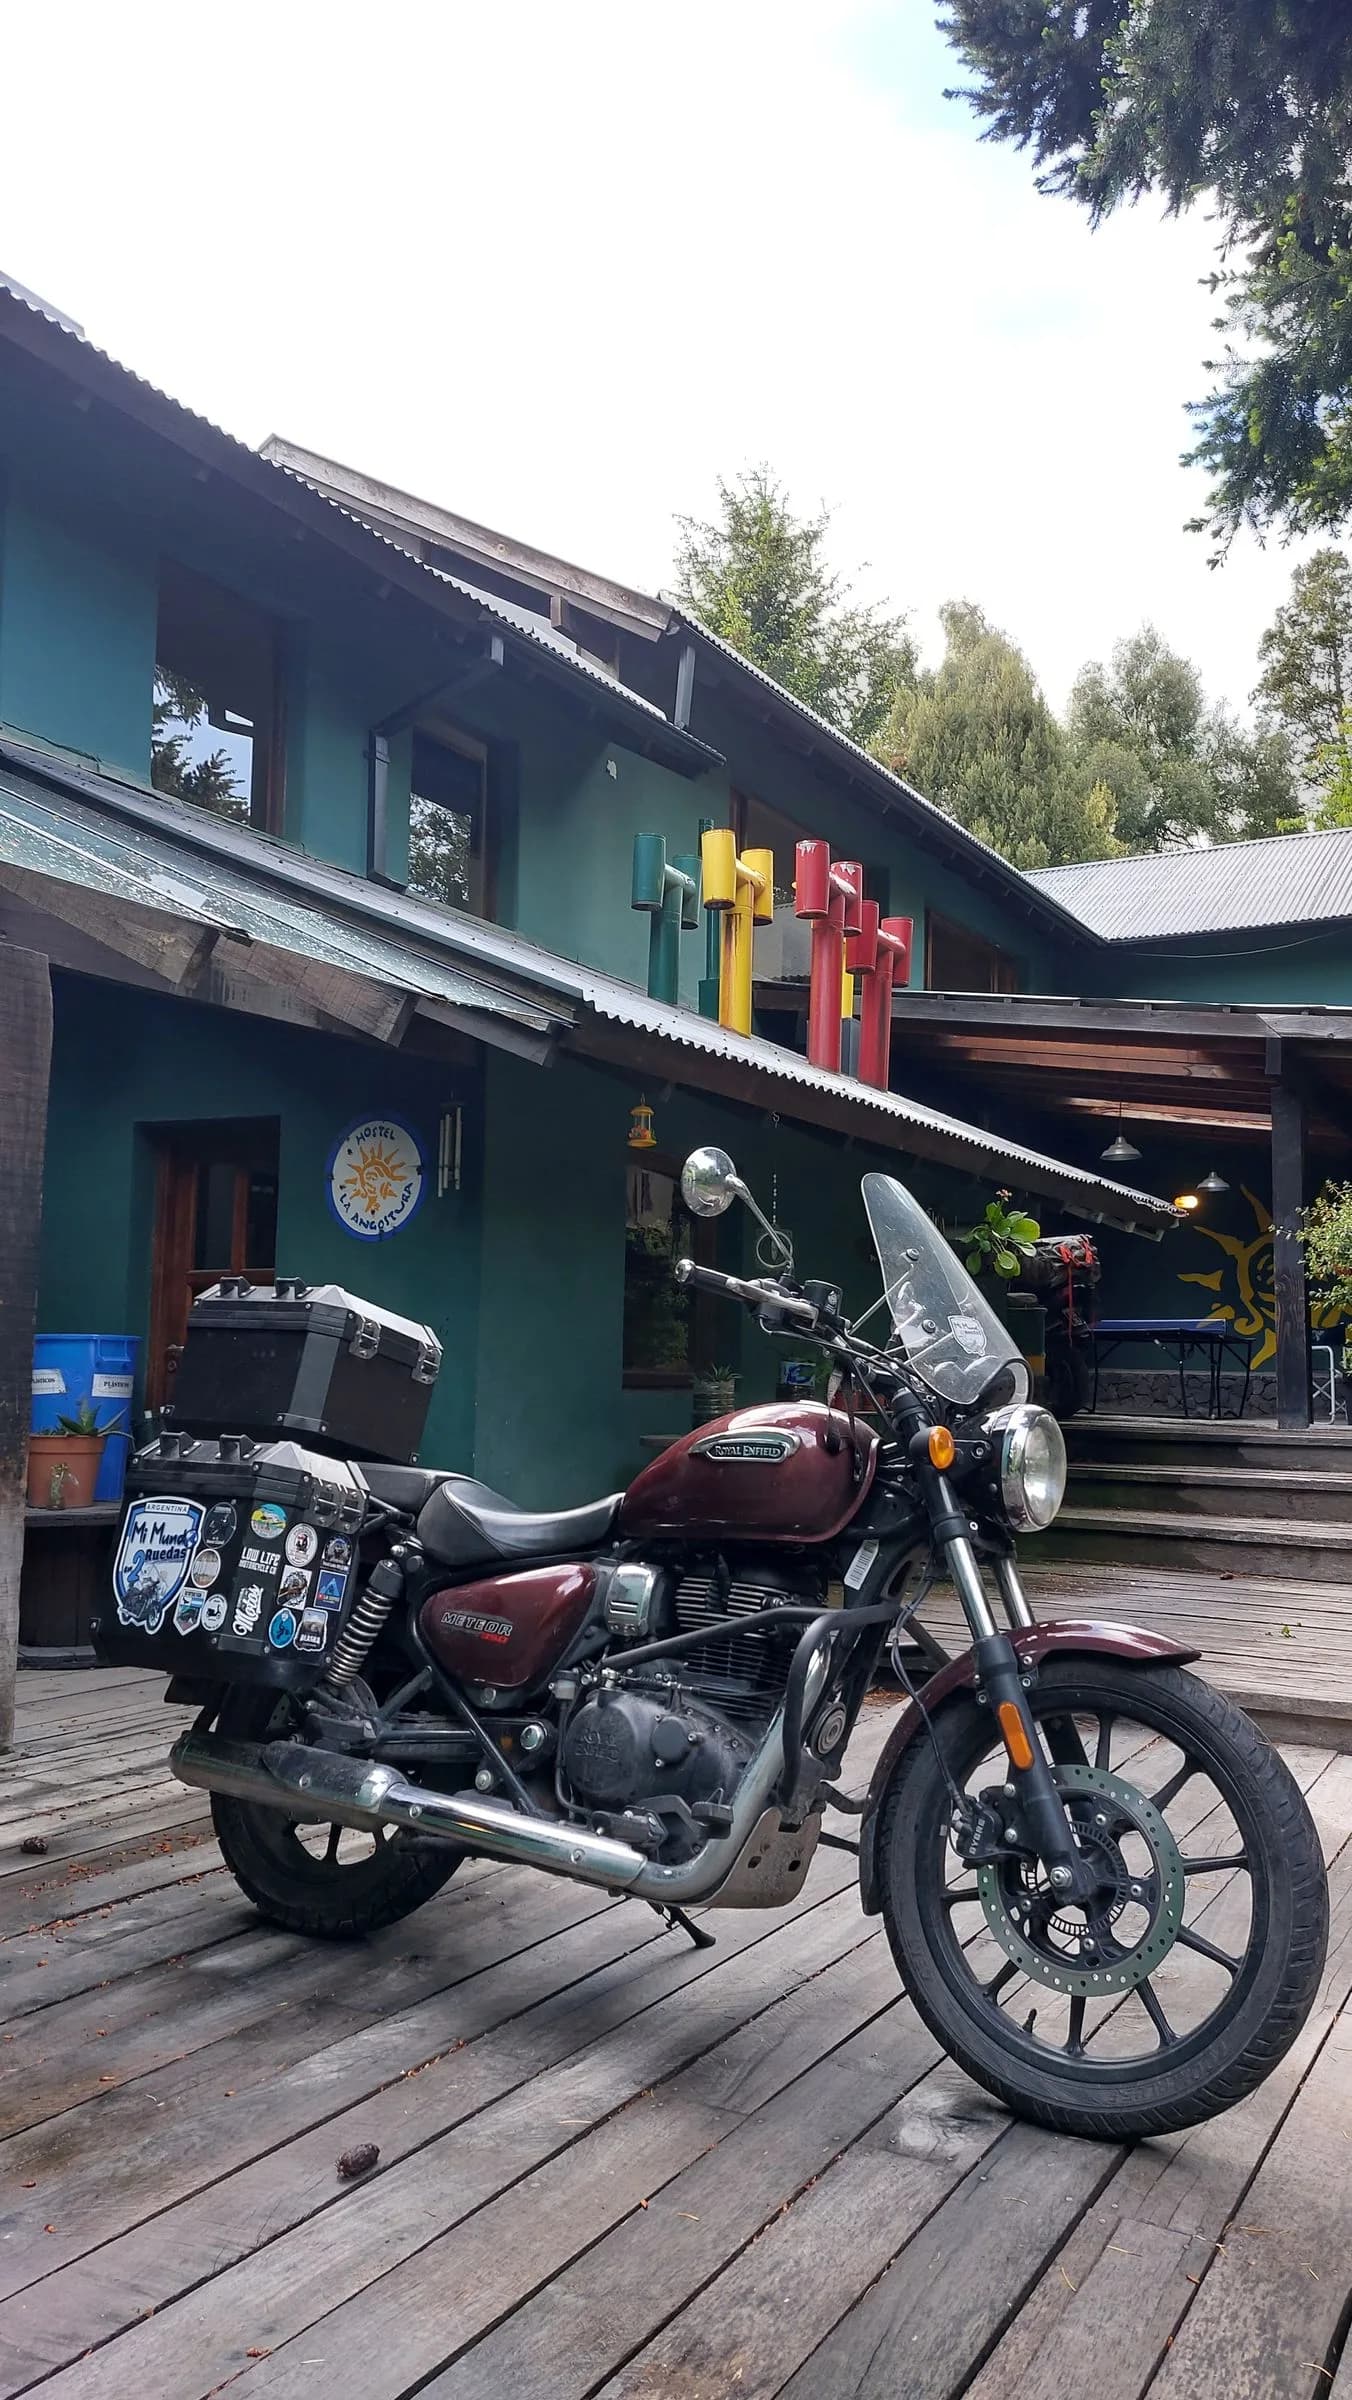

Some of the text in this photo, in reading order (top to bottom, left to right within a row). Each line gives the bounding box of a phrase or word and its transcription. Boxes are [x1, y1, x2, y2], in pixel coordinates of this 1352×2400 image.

[356, 1125, 395, 1145] HOSTEL
[339, 1182, 414, 1231] LA ANGOSTURA
[715, 1445, 781, 1457] ROYAL ENFIELD
[146, 1503, 188, 1513] ARGENTINA
[130, 1521, 148, 1544] Mi
[127, 1550, 146, 1582] 2
[144, 1547, 187, 1562] Ruedas
[241, 1546, 260, 1562] LOW
[260, 1551, 281, 1566] LIFE
[441, 1611, 513, 1637] METEOR
[969, 1818, 985, 1855] BYBRE
